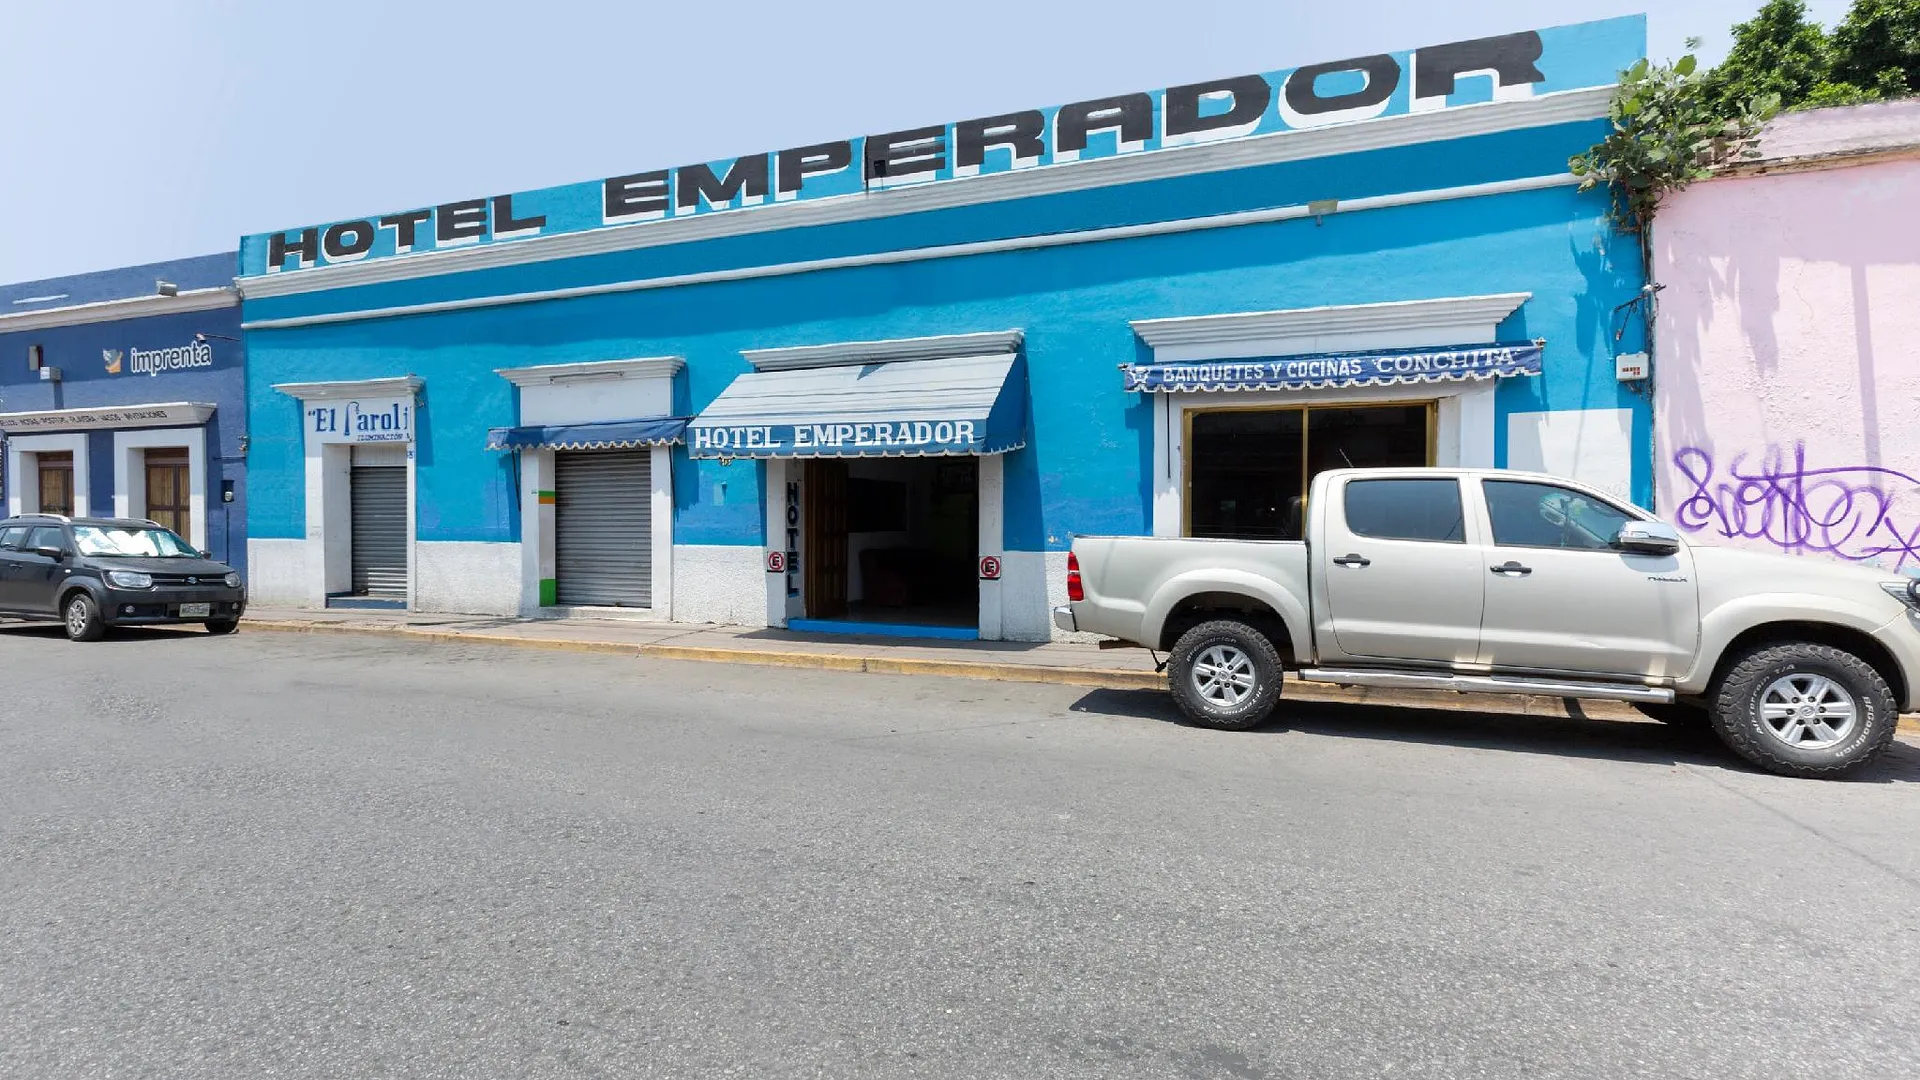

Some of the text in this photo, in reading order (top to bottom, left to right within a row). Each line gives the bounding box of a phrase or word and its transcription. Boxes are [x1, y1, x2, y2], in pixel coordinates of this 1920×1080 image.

[267, 30, 1545, 272] HOTEL EMPERADOR
[131, 341, 212, 377] imprenta
[1163, 363, 1265, 382] BANQUETES
[1270, 363, 1283, 379] Y
[1286, 358, 1363, 378] COCINAS
[695, 421, 974, 449] HOTEL EMPERADOR
[787, 482, 800, 597] HOTEL
